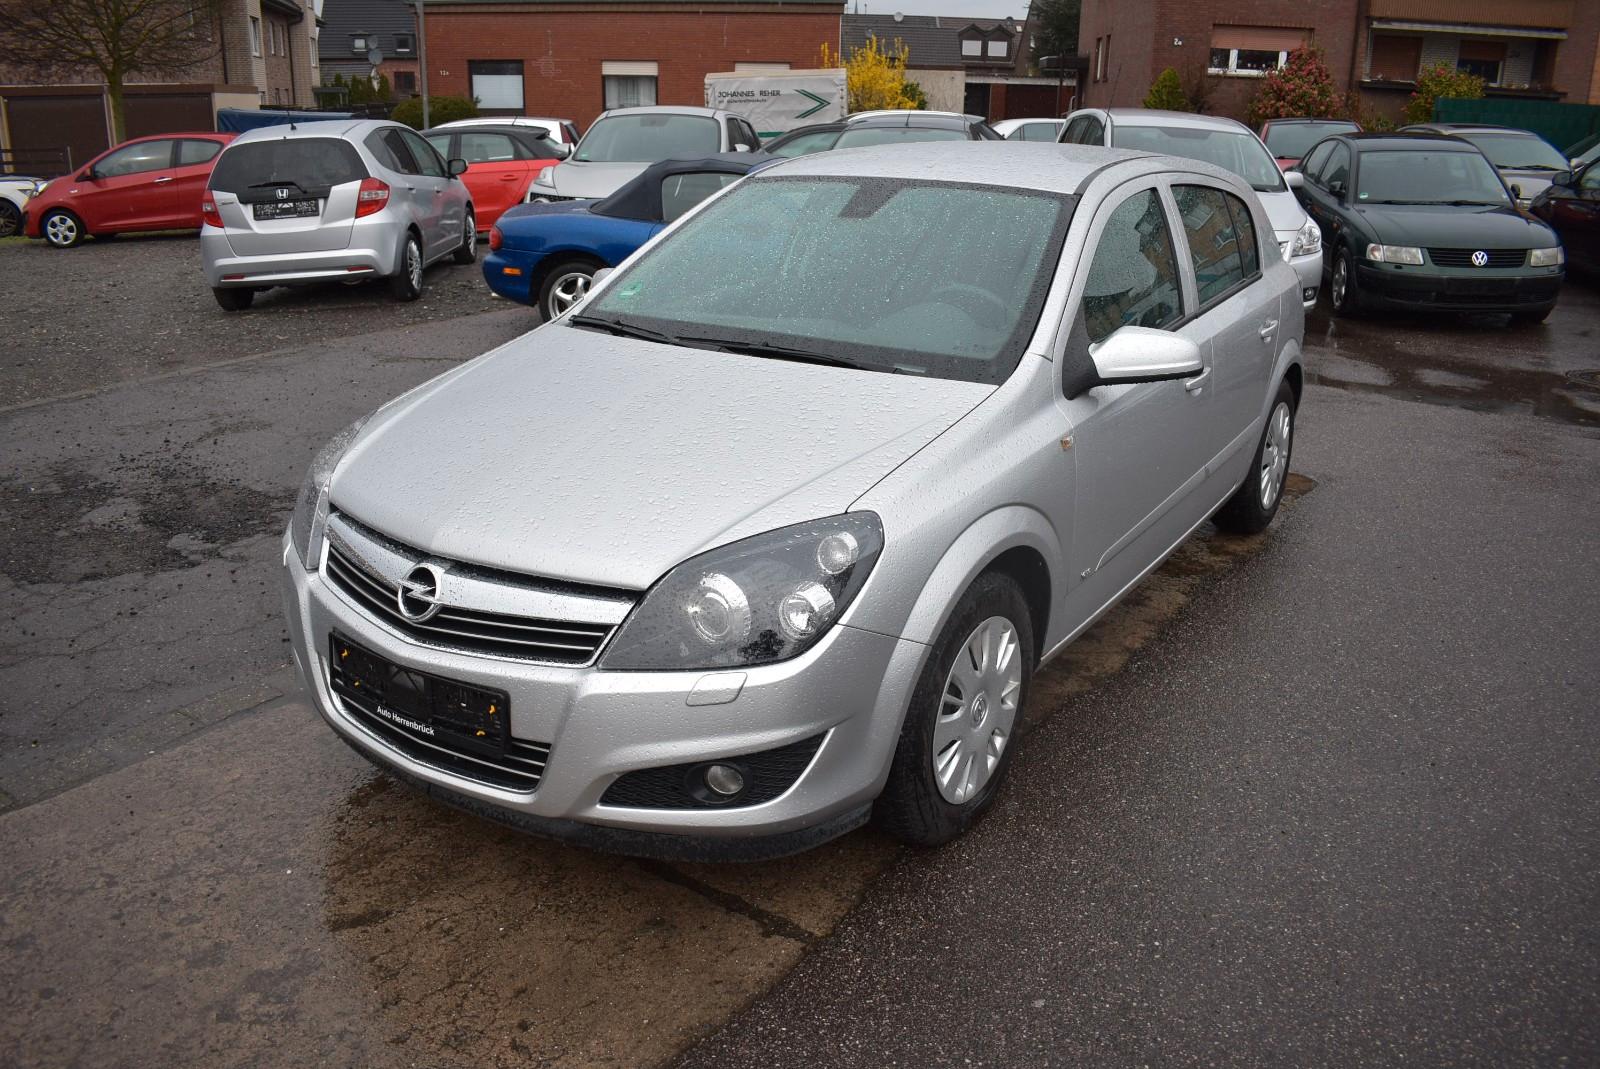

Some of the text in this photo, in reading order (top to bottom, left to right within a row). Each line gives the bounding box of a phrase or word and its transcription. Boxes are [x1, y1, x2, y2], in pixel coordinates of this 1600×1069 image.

[718, 89, 781, 98] JOHANNES REHER
[376, 705, 435, 736] Auto Herrenbrück
